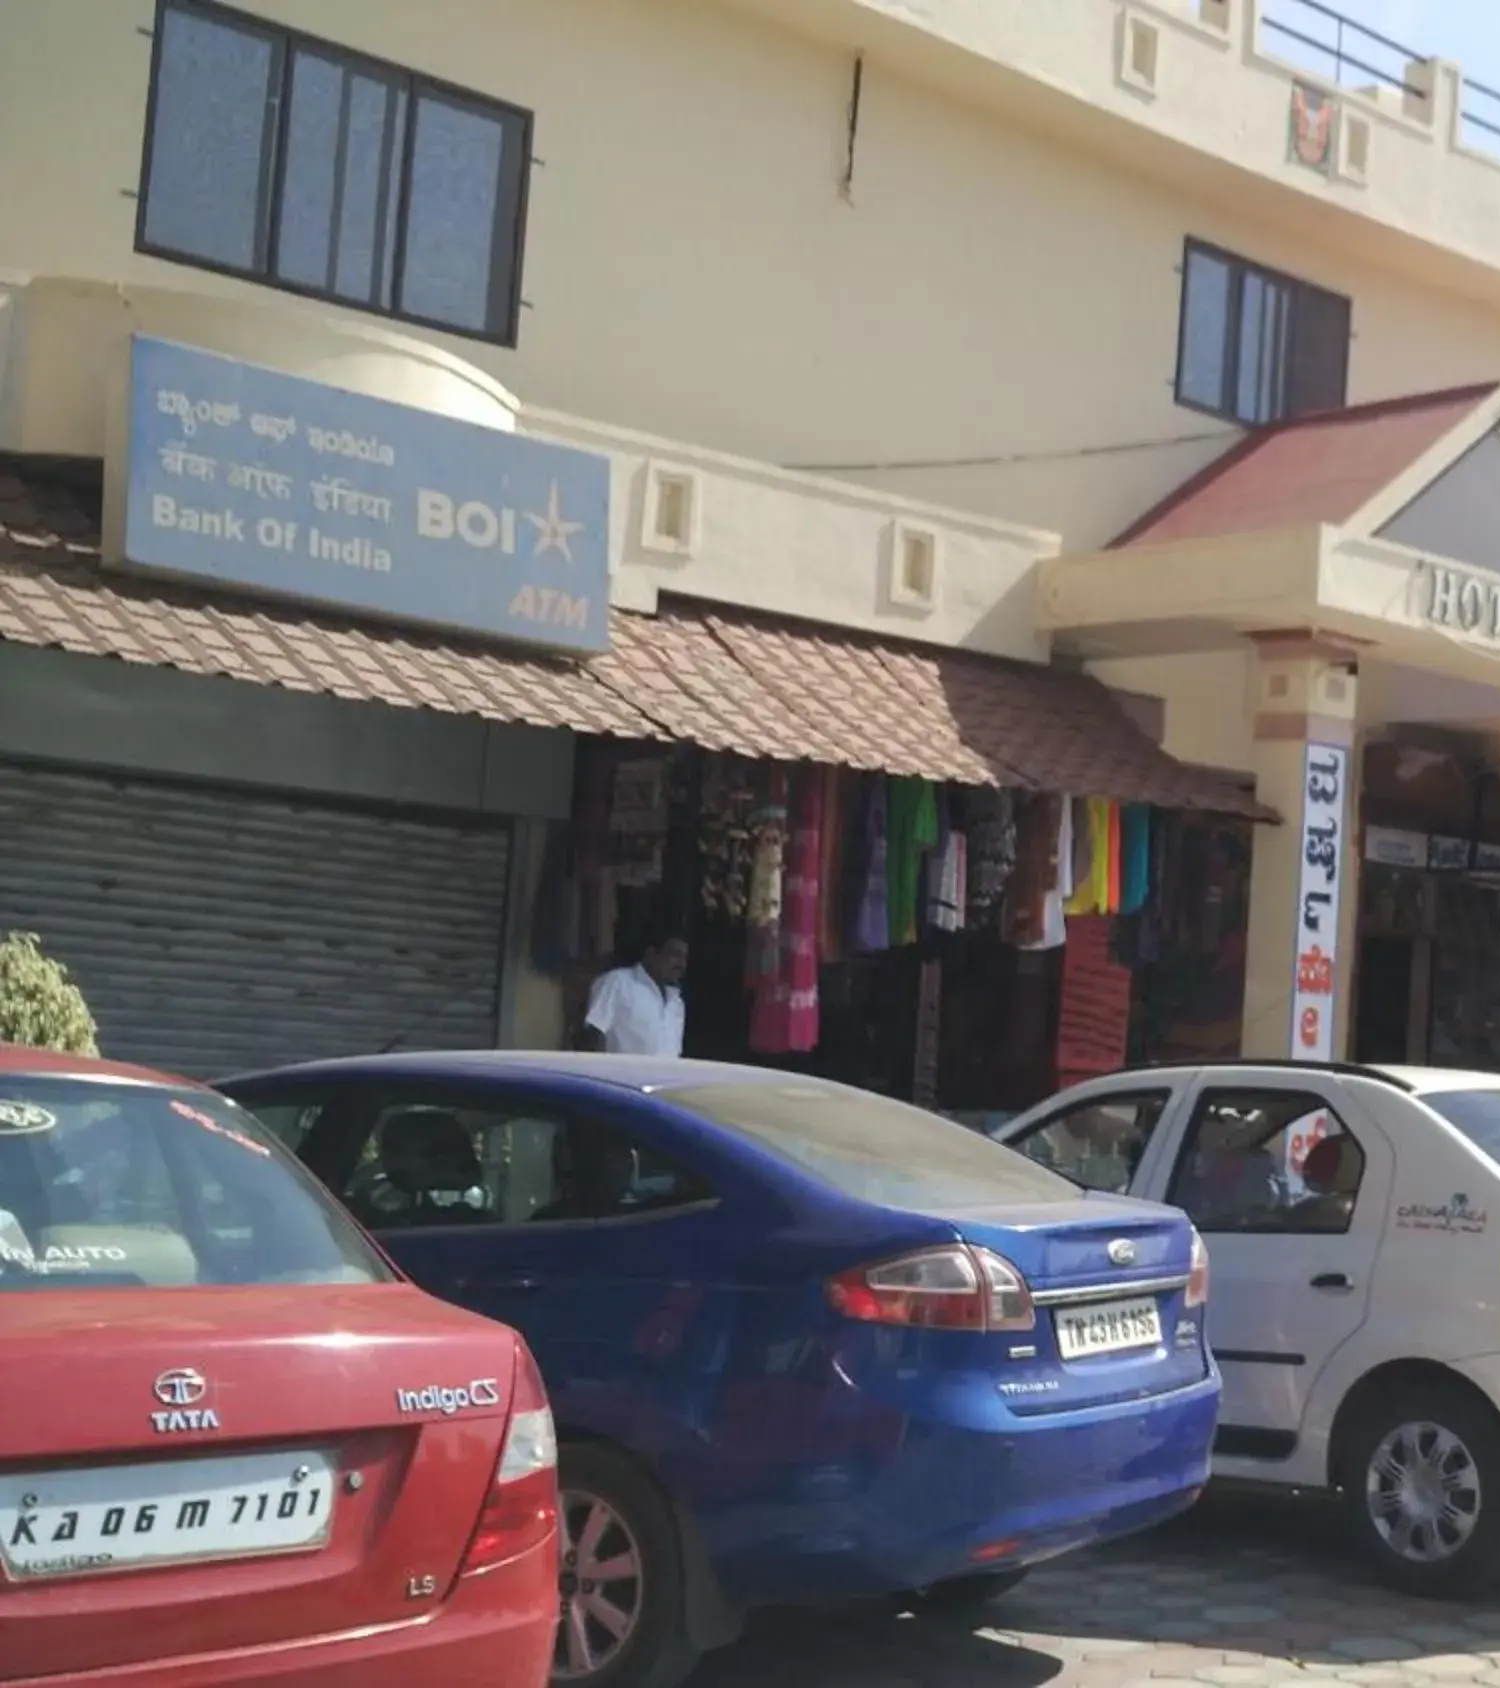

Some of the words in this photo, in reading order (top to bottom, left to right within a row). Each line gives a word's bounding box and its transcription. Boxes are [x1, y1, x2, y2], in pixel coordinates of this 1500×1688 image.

[152, 494, 245, 543] Bank
[257, 517, 298, 553] Of
[309, 527, 393, 574] India
[417, 488, 518, 554] BOI
[509, 585, 591, 630] ATM
[46, 1245, 127, 1262] AUTO
[151, 1410, 219, 1433] TATA
[230, 1488, 322, 1524] 7101
[408, 1575, 436, 1596] LS
